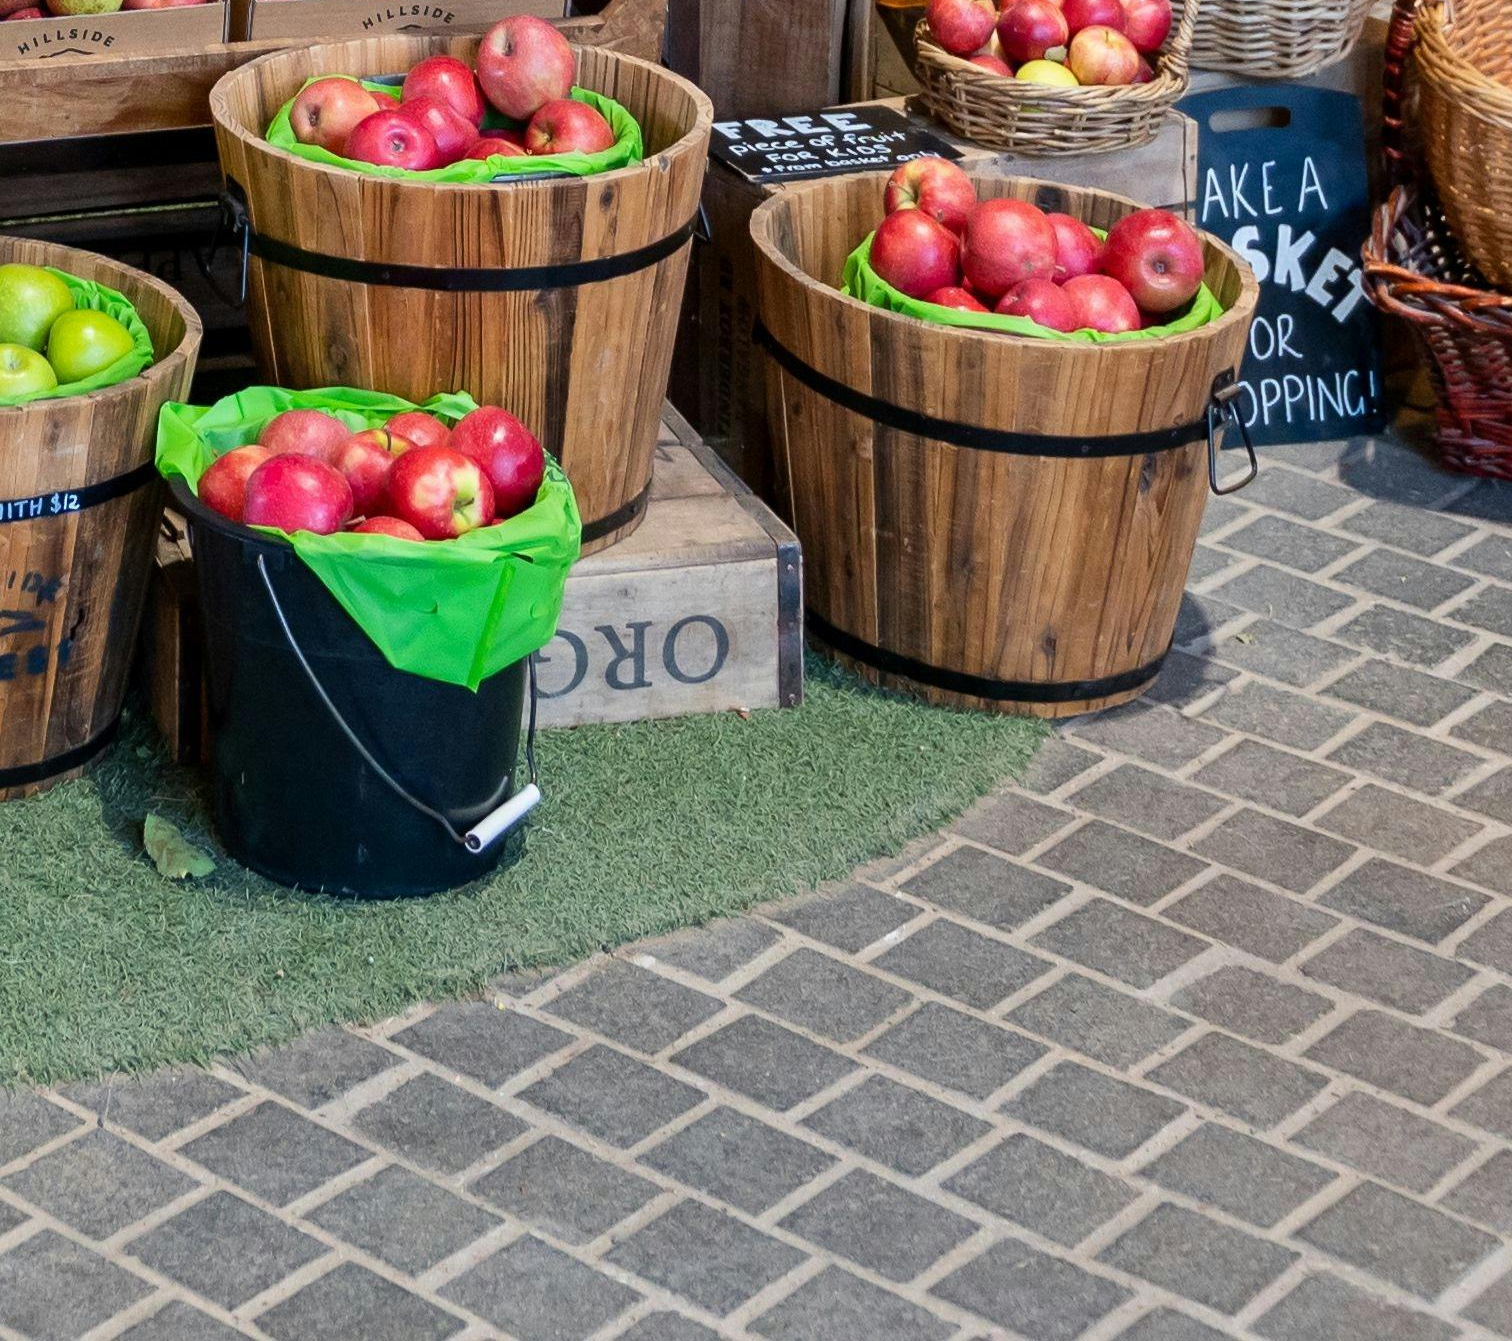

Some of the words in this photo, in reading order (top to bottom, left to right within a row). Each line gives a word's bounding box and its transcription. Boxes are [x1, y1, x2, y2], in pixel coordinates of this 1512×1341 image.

[361, 4, 455, 31] HILLSIDE
[16, 28, 115, 55] HILLSIDE
[712, 112, 873, 140] FREE
[729, 138, 805, 157] piece
[809, 134, 837, 148] of
[842, 130, 907, 146] fruit
[765, 150, 819, 164] FOR
[826, 144, 892, 159] KIDS
[824, 154, 890, 166] basket
[1202, 160, 1284, 223] AKE
[1297, 155, 1328, 213] A
[1232, 223, 1376, 324] SKET
[1249, 313, 1304, 361] OR
[1236, 369, 1377, 428] OPPING!
[49, 492, 81, 515] $12
[531, 614, 730, 701] ORG
